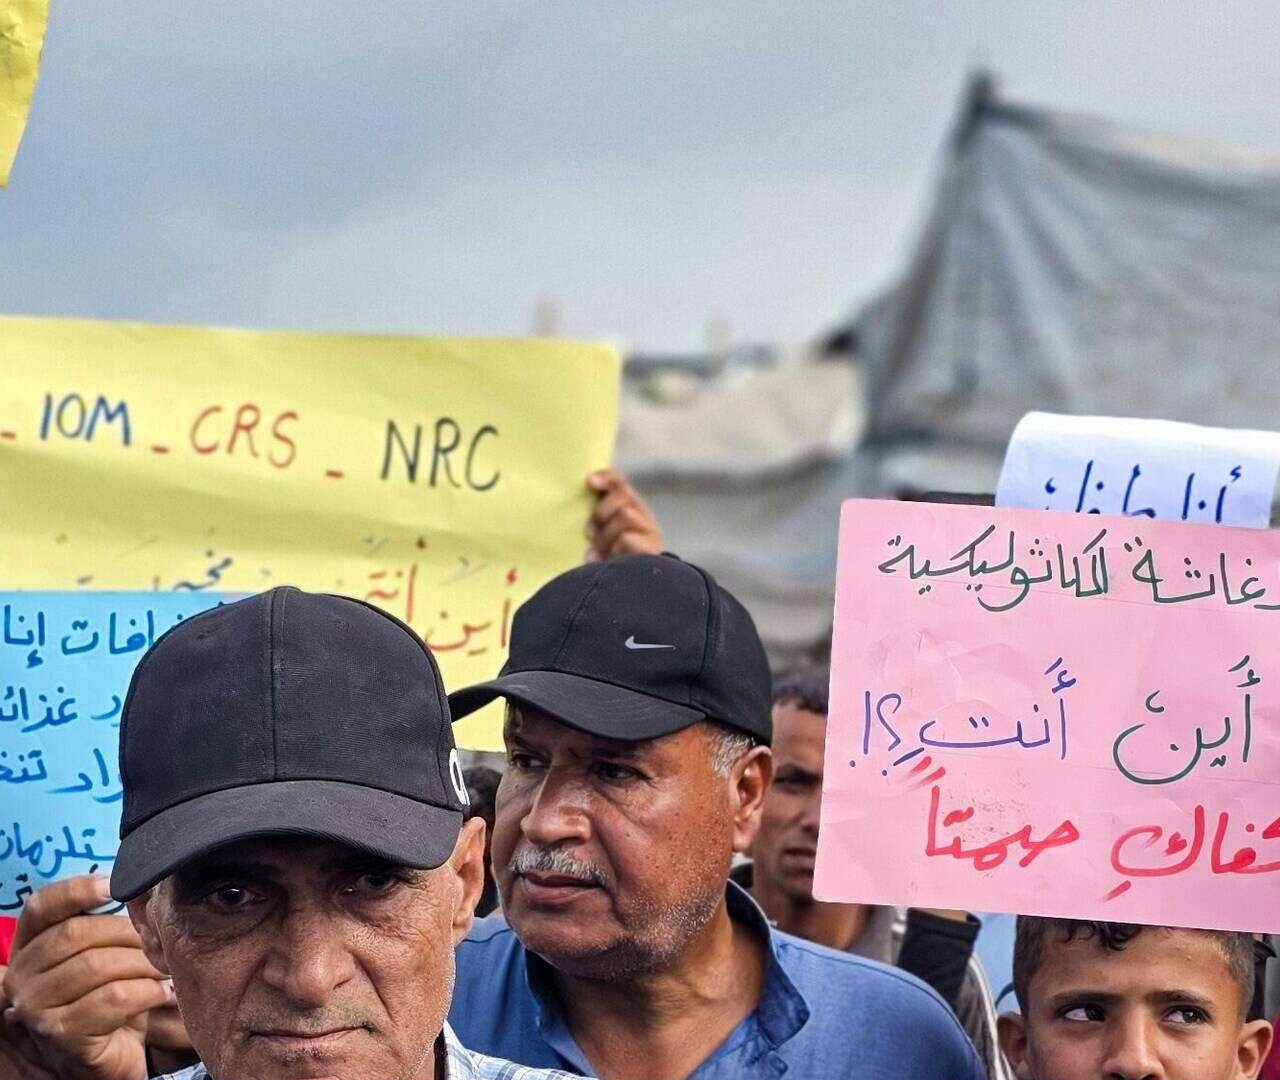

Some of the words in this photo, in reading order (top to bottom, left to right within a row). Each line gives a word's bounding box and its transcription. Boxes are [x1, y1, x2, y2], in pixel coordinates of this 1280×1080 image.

[39, 392, 132, 447] IOM
[190, 403, 299, 469] CRS
[380, 416, 501, 492] NRC
